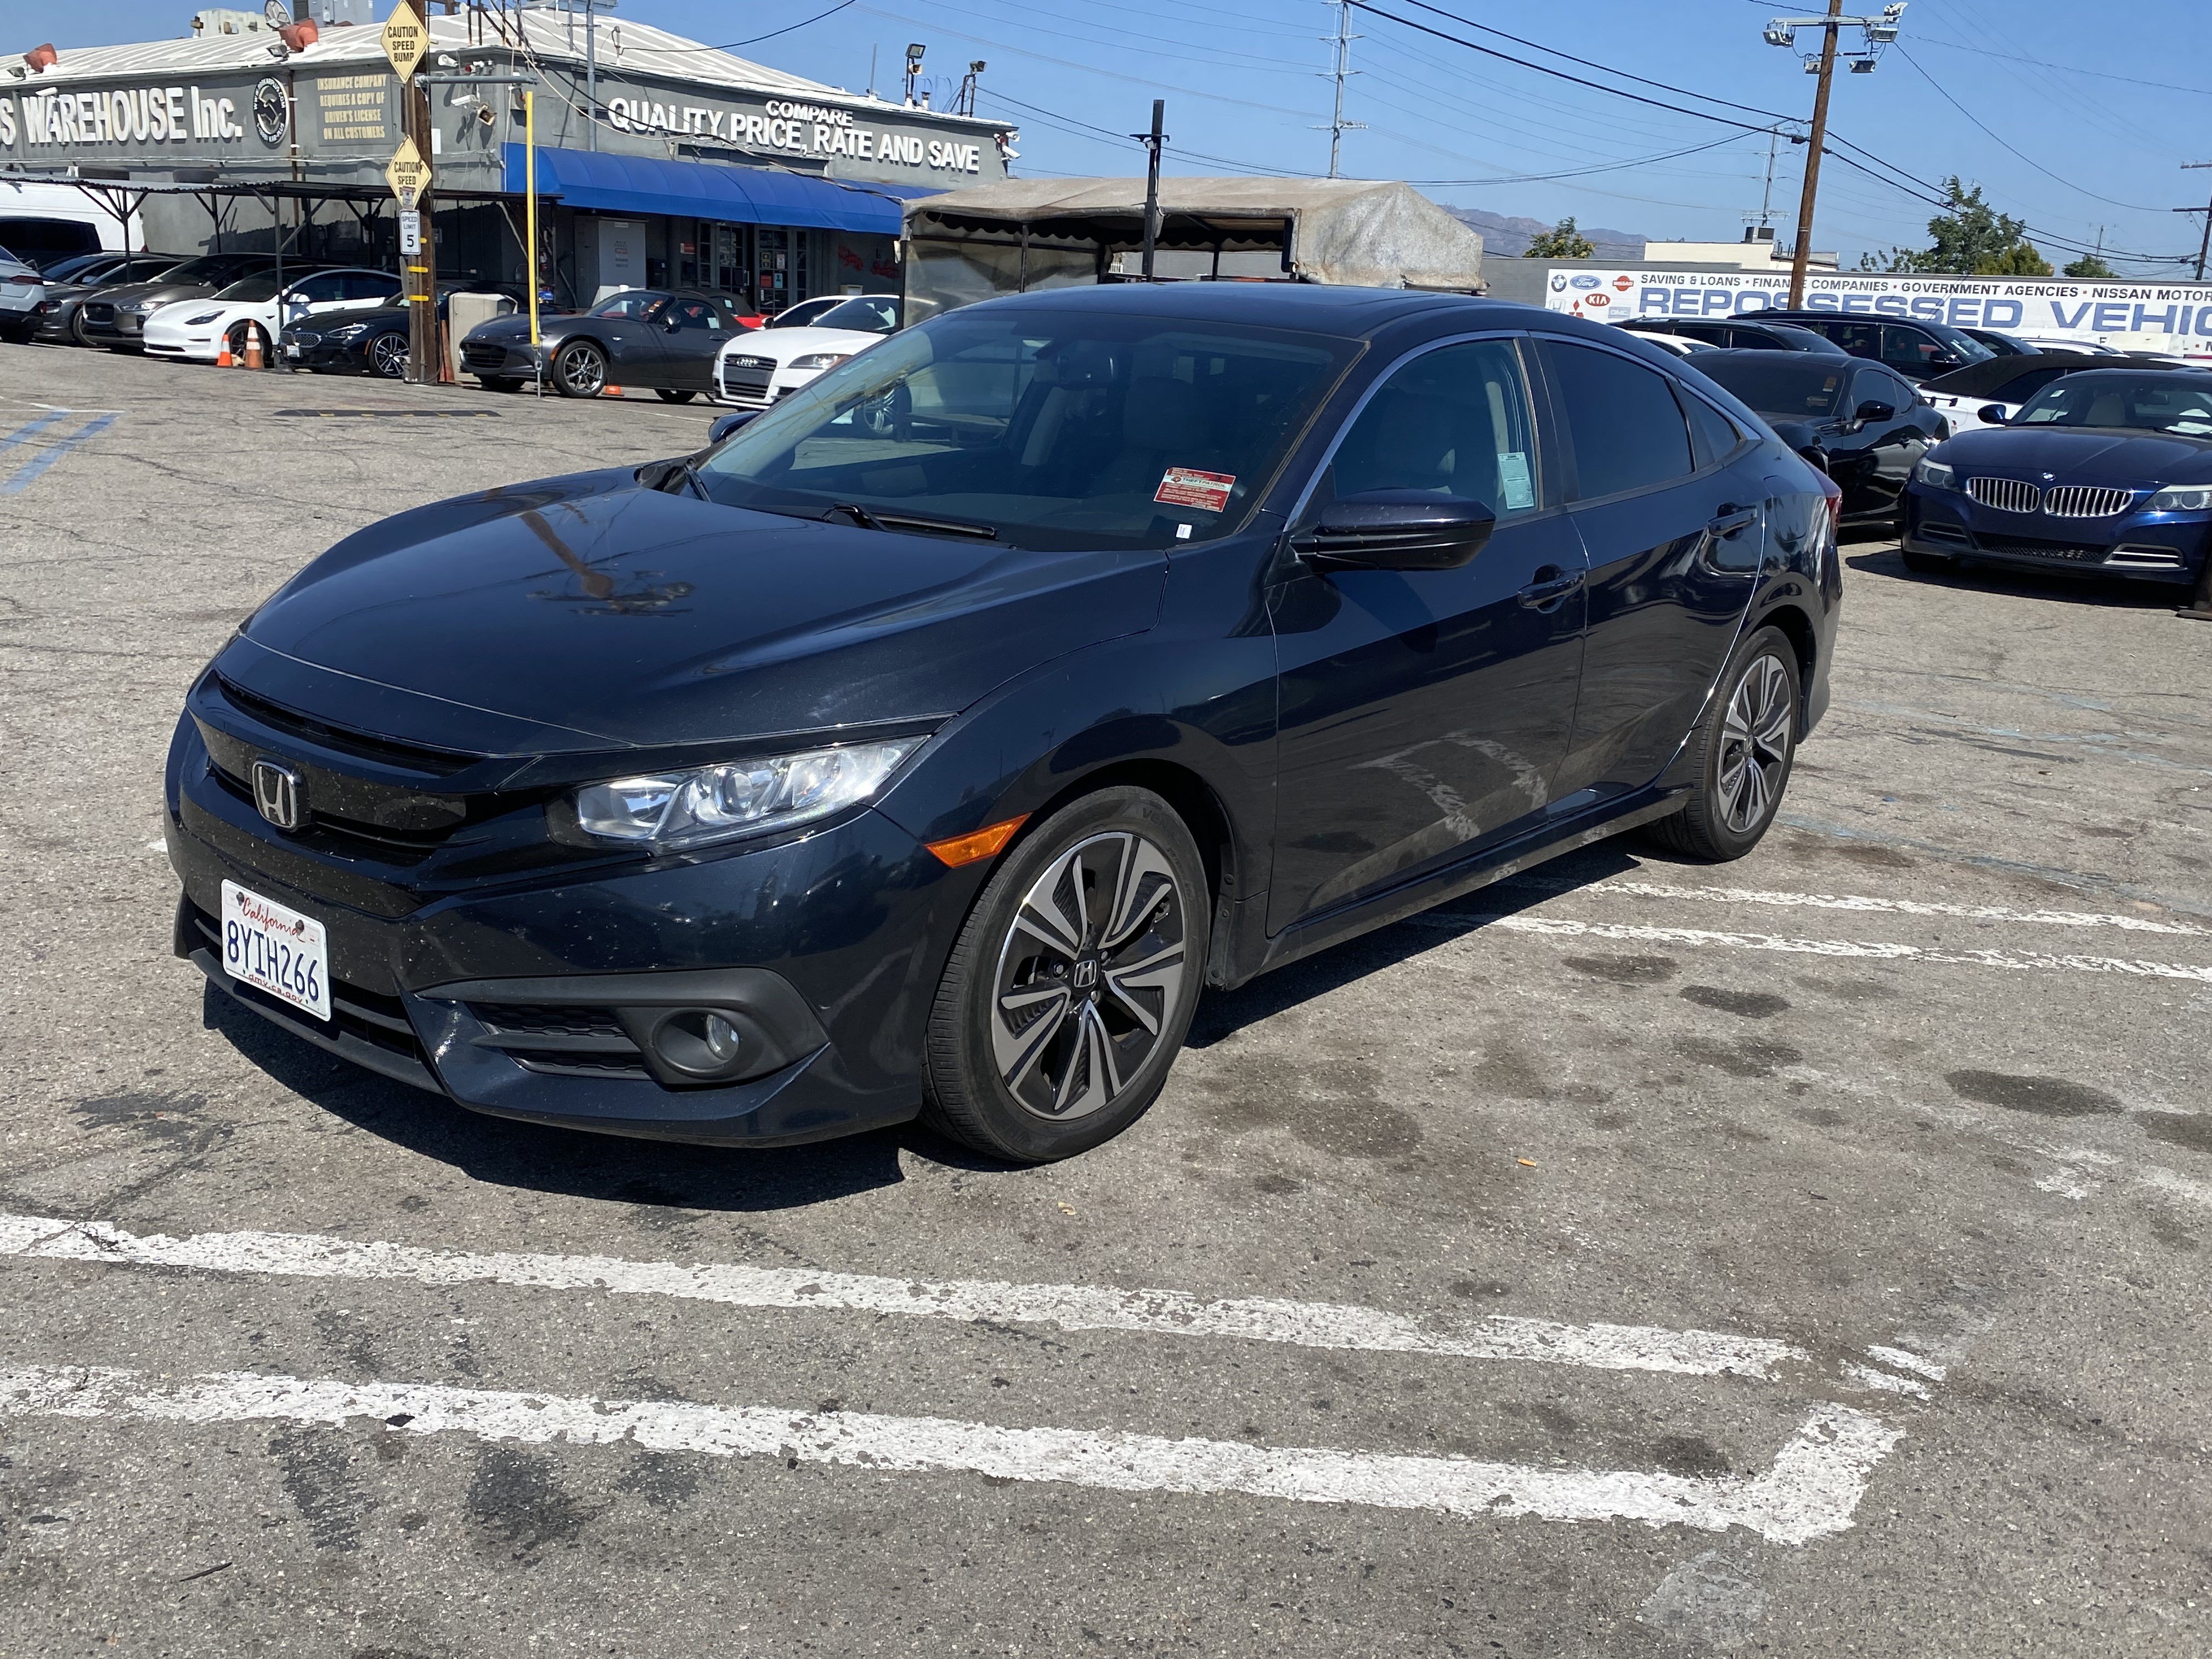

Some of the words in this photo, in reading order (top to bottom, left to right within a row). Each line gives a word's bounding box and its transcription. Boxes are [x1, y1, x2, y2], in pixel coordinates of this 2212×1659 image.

[388, 26, 418, 38] CAUTION
[392, 41, 415, 50] SPEED
[394, 53, 414, 62] BUMP
[317, 77, 353, 91] INSURANCE
[354, 74, 386, 88] COMPANY
[320, 93, 351, 108] REQUIRES
[351, 93, 356, 105] A
[357, 92, 375, 105] COPY
[376, 91, 385, 104] OF
[21, 87, 187, 144] WAREHOUSE
[191, 86, 242, 139] Inc.
[325, 110, 353, 123] DRIVER'S
[354, 109, 381, 122] LICENSE
[765, 100, 853, 127] COMPARE
[323, 127, 332, 140] ON
[334, 127, 345, 139] ALL
[345, 126, 385, 139] CUSTOMERS
[730, 113, 808, 156] PRICE,
[814, 125, 873, 158] RATE
[878, 134, 924, 164] AND
[928, 140, 980, 172] SAVE
[394, 161, 420, 172] CAUTION
[398, 176, 416, 185] SPEED
[399, 187, 416, 196] BP
[407, 234, 414, 247] 5
[1641, 274, 1685, 285] SAVING
[1690, 276, 1696, 285] &
[1700, 276, 1741, 286] LOANS
[1753, 278, 1807, 289] FINANE
[1812, 279, 1888, 292] COMPANIES
[1901, 282, 2000, 295] GOVERNMENT
[2005, 285, 2079, 297] AGENCIES
[2092, 288, 2152, 300] NISSAN
[1588, 296, 1607, 304] KIA
[242, 897, 306, 943] California
[228, 920, 319, 1001] 8YIH266
[249, 974, 303, 1003] dmv.ca.gov
